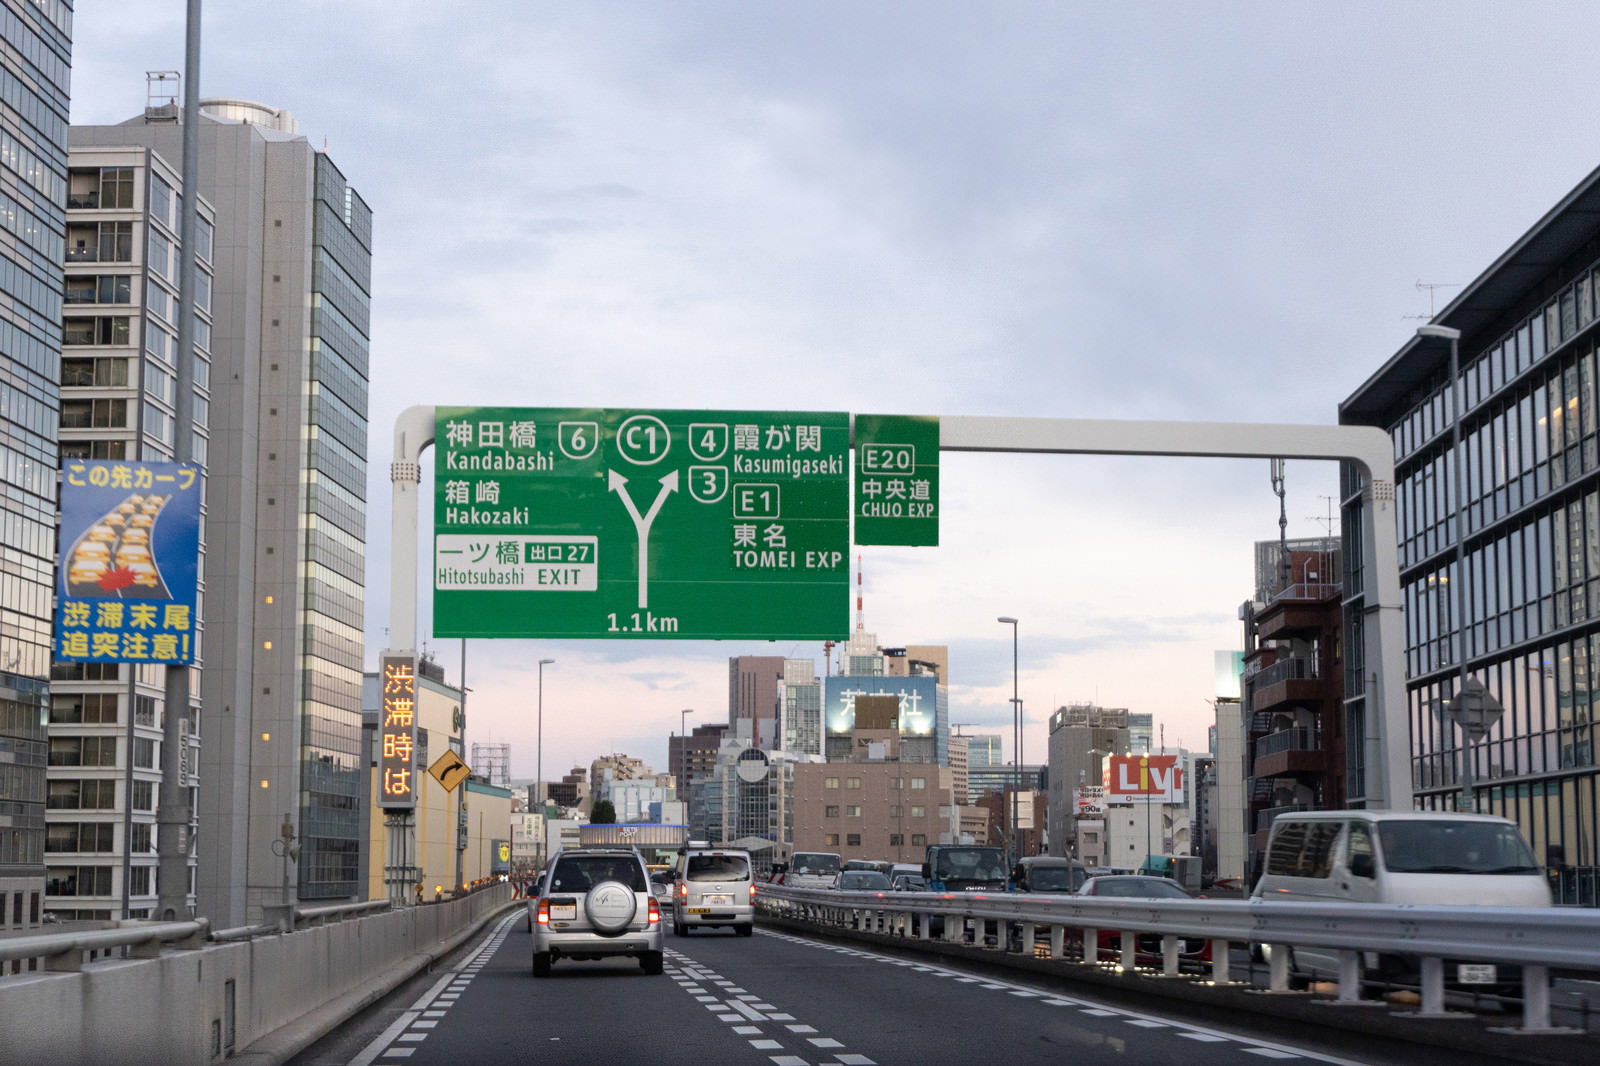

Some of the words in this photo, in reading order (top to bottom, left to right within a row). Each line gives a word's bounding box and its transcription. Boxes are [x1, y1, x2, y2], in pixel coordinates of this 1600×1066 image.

[446, 420, 536, 448] 神田橋
[571, 427, 586, 451] 6
[626, 426, 656, 454] C1
[700, 430, 716, 452] 4
[733, 424, 821, 451] 霞が関
[446, 451, 554, 471] Kandabashi
[733, 454, 843, 479] Kasumigaseki
[867, 450, 910, 469] E20
[68, 464, 198, 491] この先カーブ
[702, 471, 716, 494] 3
[445, 480, 500, 505] 箱崎
[742, 490, 770, 512] E1
[861, 479, 931, 500] 中央道
[446, 507, 529, 525] Hakozaki
[861, 502, 902, 518] CHUO
[908, 503, 935, 518] EXP
[733, 523, 787, 548] 東名
[439, 541, 520, 565] 一ツ橋
[733, 550, 796, 568] TOMEI
[805, 551, 842, 568] EXP
[438, 567, 525, 585] Hitotsubashi
[537, 569, 581, 585] EXIT
[61, 601, 190, 630] 渋滞末尾
[607, 612, 679, 632] 1.1km
[384, 664, 414, 795] 渋滞時は
